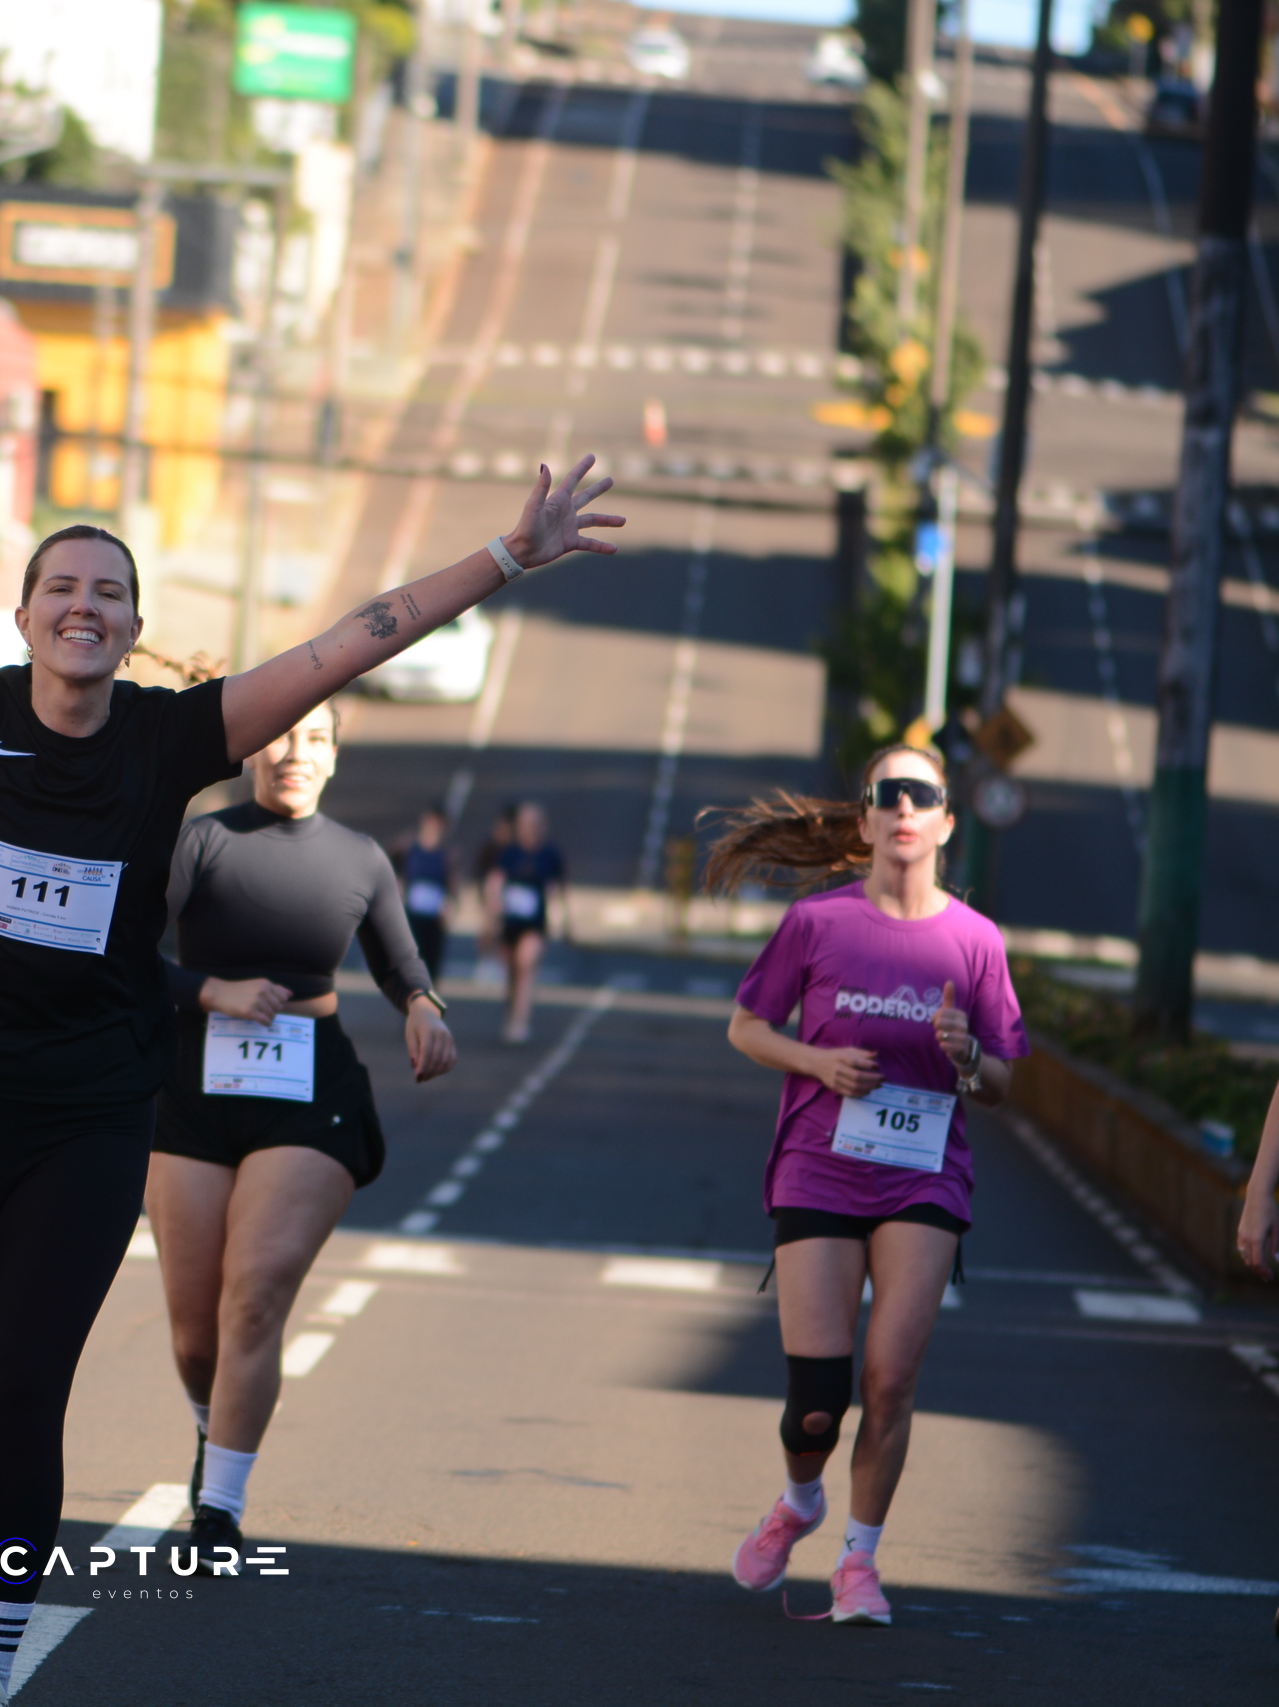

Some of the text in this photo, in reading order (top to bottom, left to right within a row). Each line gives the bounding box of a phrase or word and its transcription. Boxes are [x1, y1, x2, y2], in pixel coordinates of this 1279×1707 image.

[11, 877, 71, 907] 111
[835, 991, 943, 1023] PODEROS
[238, 1040, 282, 1062] 171
[875, 1108, 921, 1133] 105
